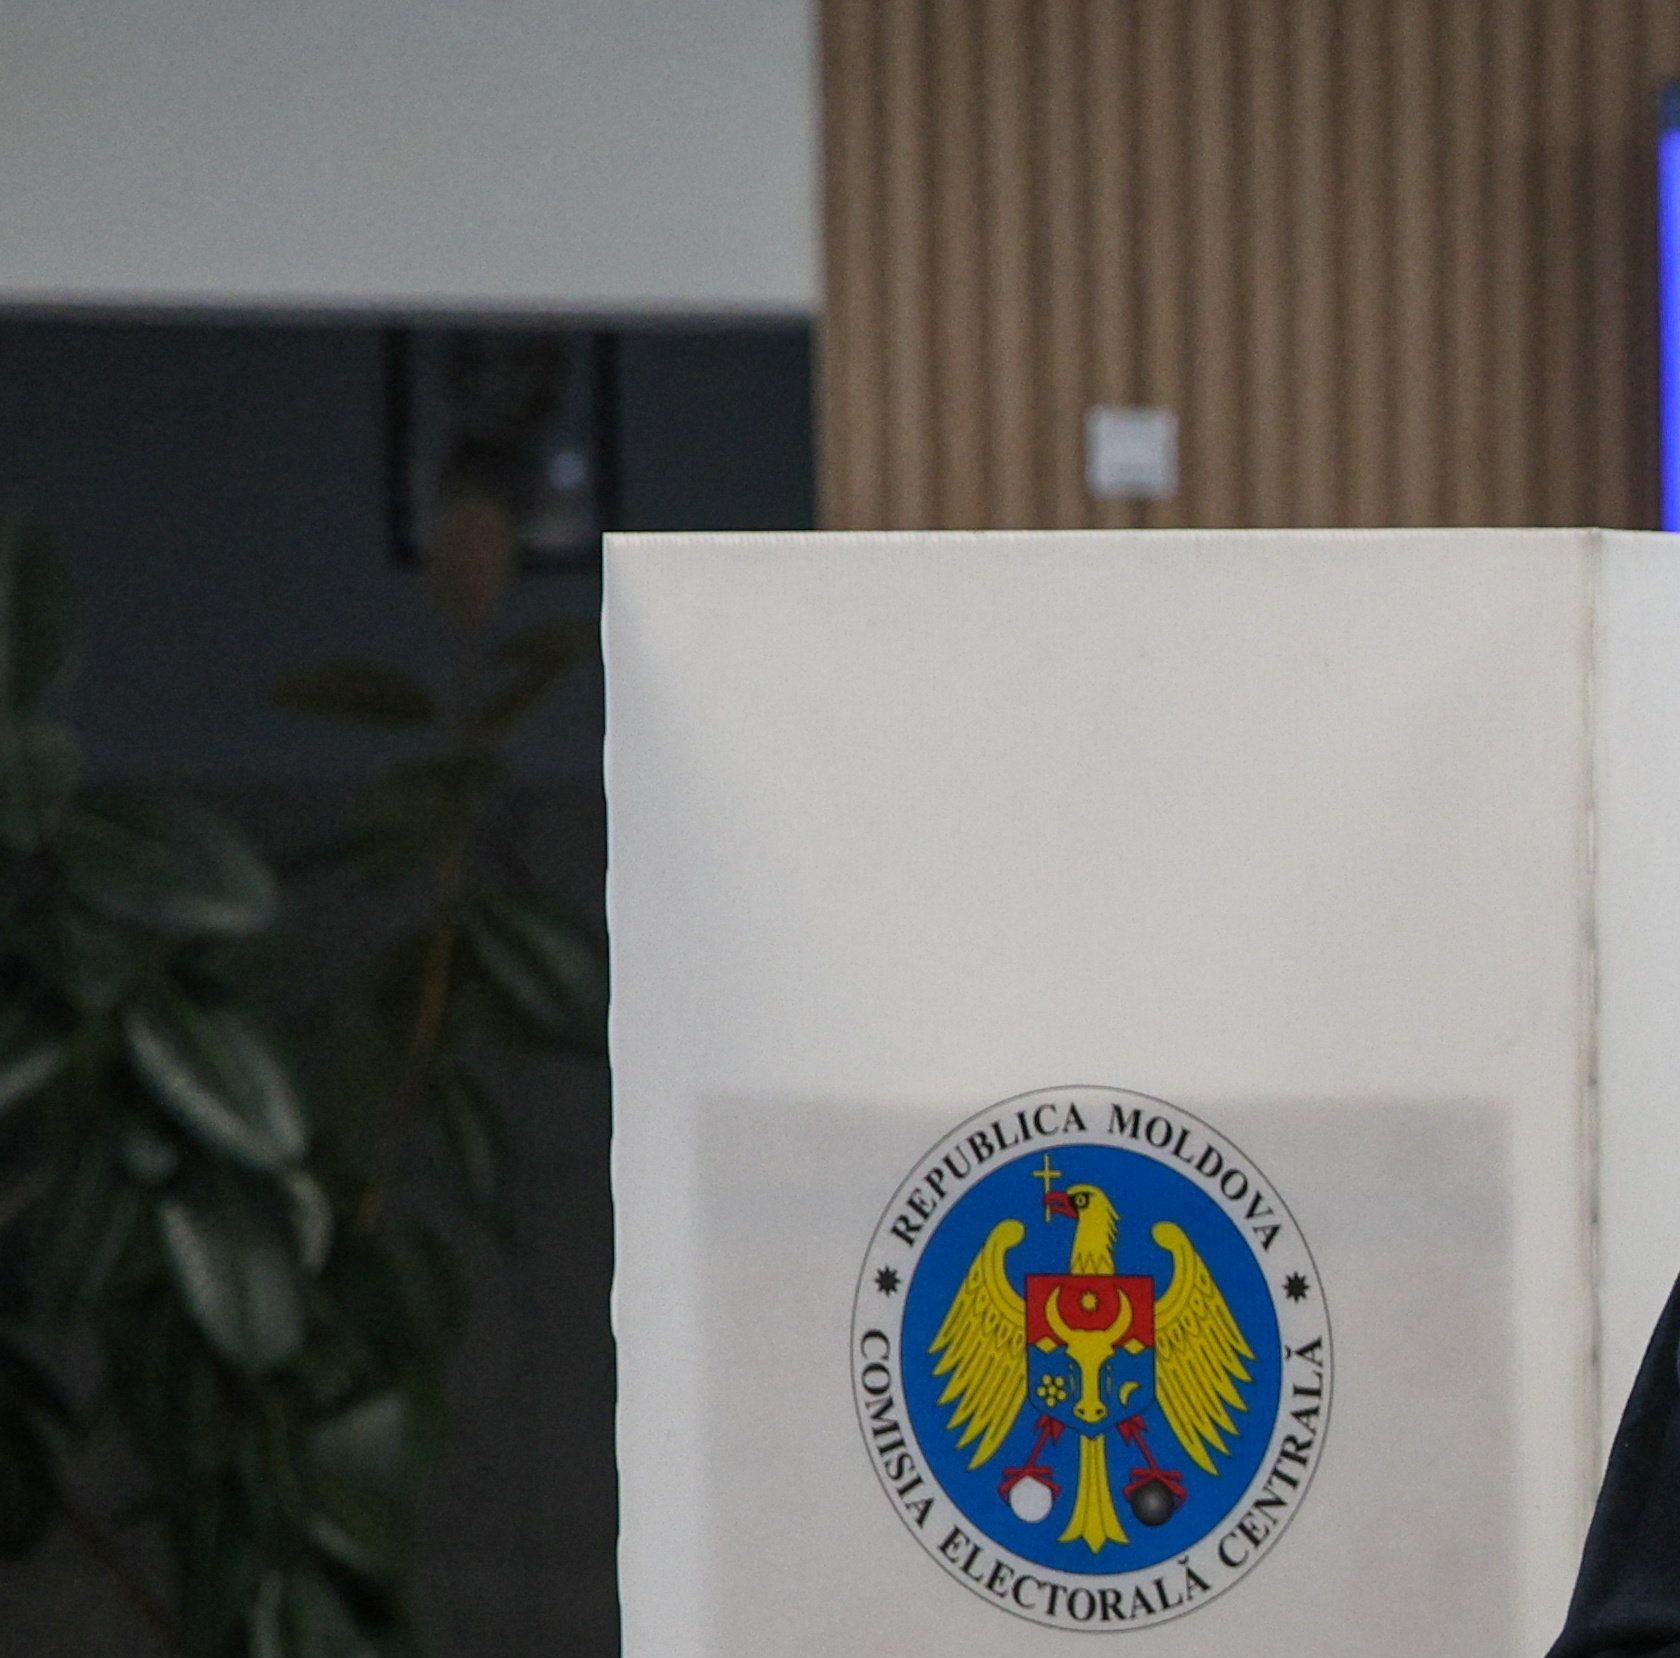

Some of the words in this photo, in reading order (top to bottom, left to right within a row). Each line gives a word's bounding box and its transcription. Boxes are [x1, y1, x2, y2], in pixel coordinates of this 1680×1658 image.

[889, 1102, 1088, 1249] REPUBLICA
[1107, 1103, 1285, 1252] MOLDOVA
[860, 1329, 935, 1529] COMISIA
[936, 1524, 1212, 1623] ELECTORALĂ
[1217, 1336, 1324, 1569] CENTRALĂ
